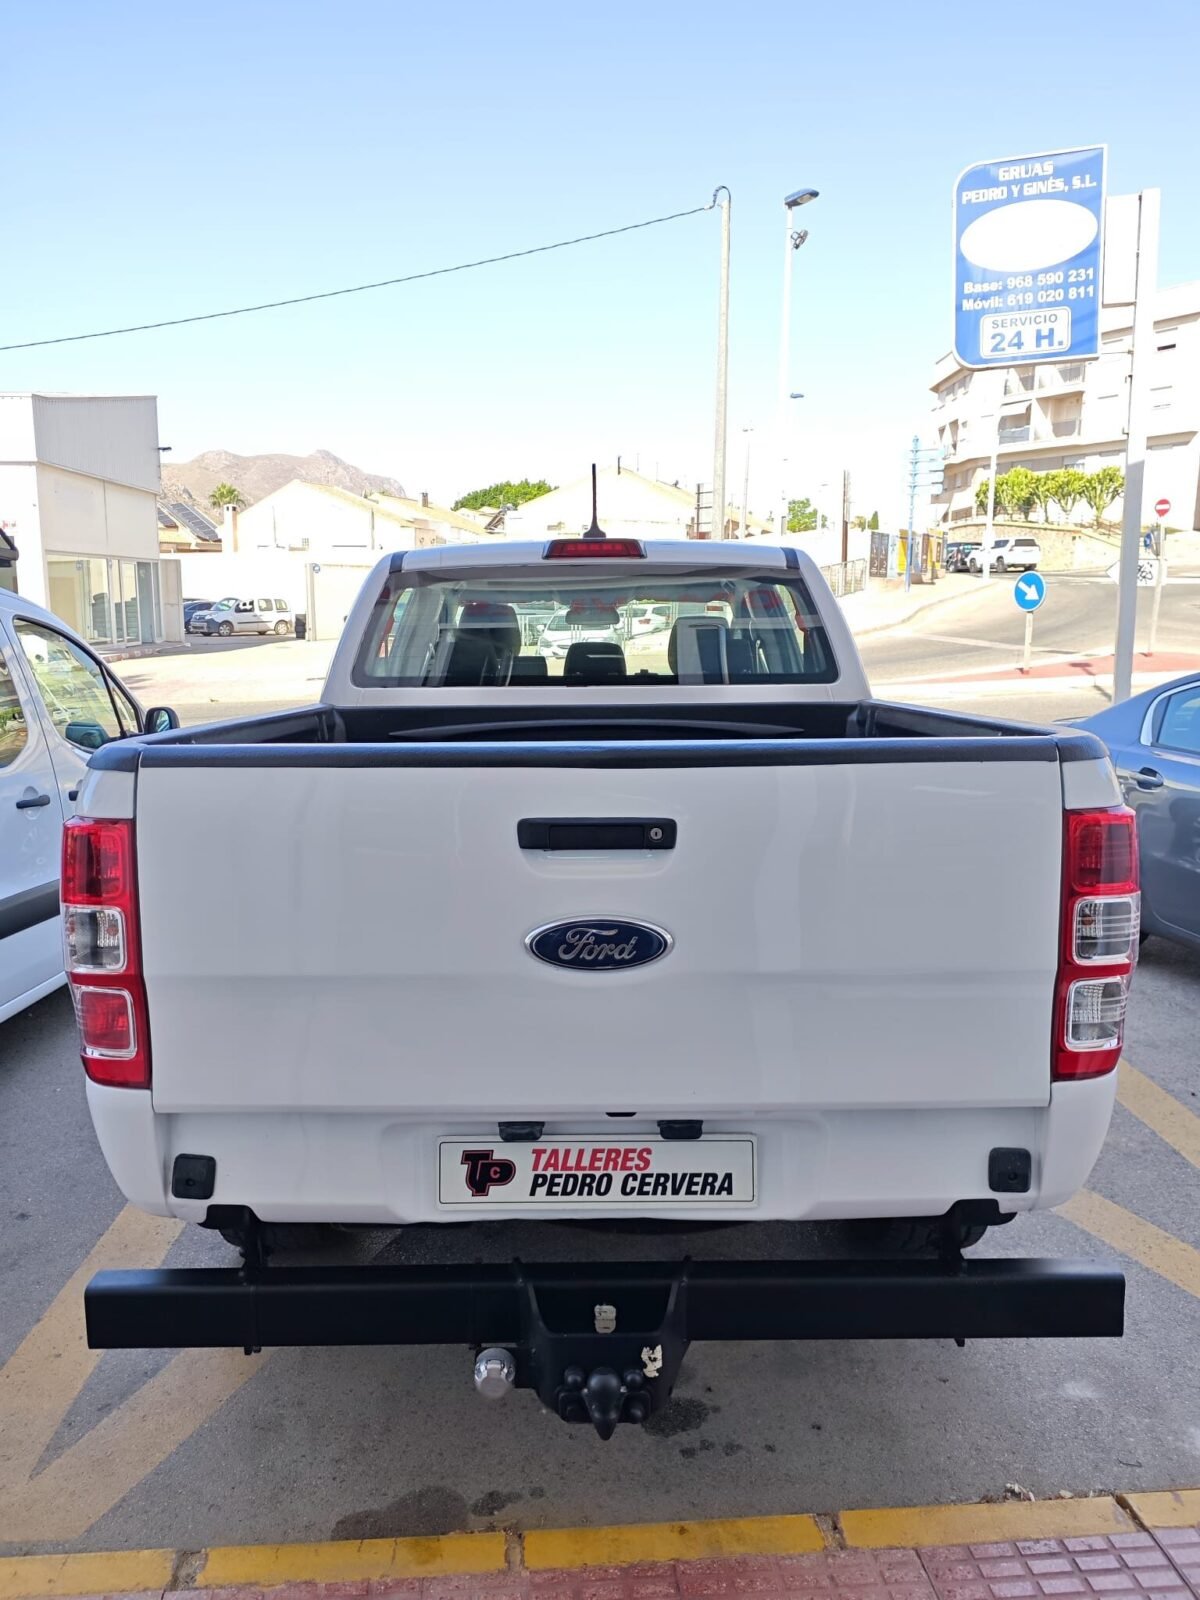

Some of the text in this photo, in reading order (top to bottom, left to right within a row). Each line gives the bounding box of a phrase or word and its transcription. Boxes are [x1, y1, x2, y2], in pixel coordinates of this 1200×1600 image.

[998, 160, 1054, 181] GRUAS
[961, 186, 1008, 204] PEDRO
[1011, 184, 1021, 198] Y
[1023, 176, 1069, 196] GINÉS,
[963, 267, 1094, 294] Base: 968 590 231
[962, 285, 1094, 311] Móvil: 619 020 811
[991, 313, 1058, 329] SERVICIO
[990, 327, 1064, 353] 24 H.
[558, 927, 639, 960] Ford
[531, 1147, 653, 1172] TALLERES
[528, 1172, 734, 1197] PEDRO CERVERA
